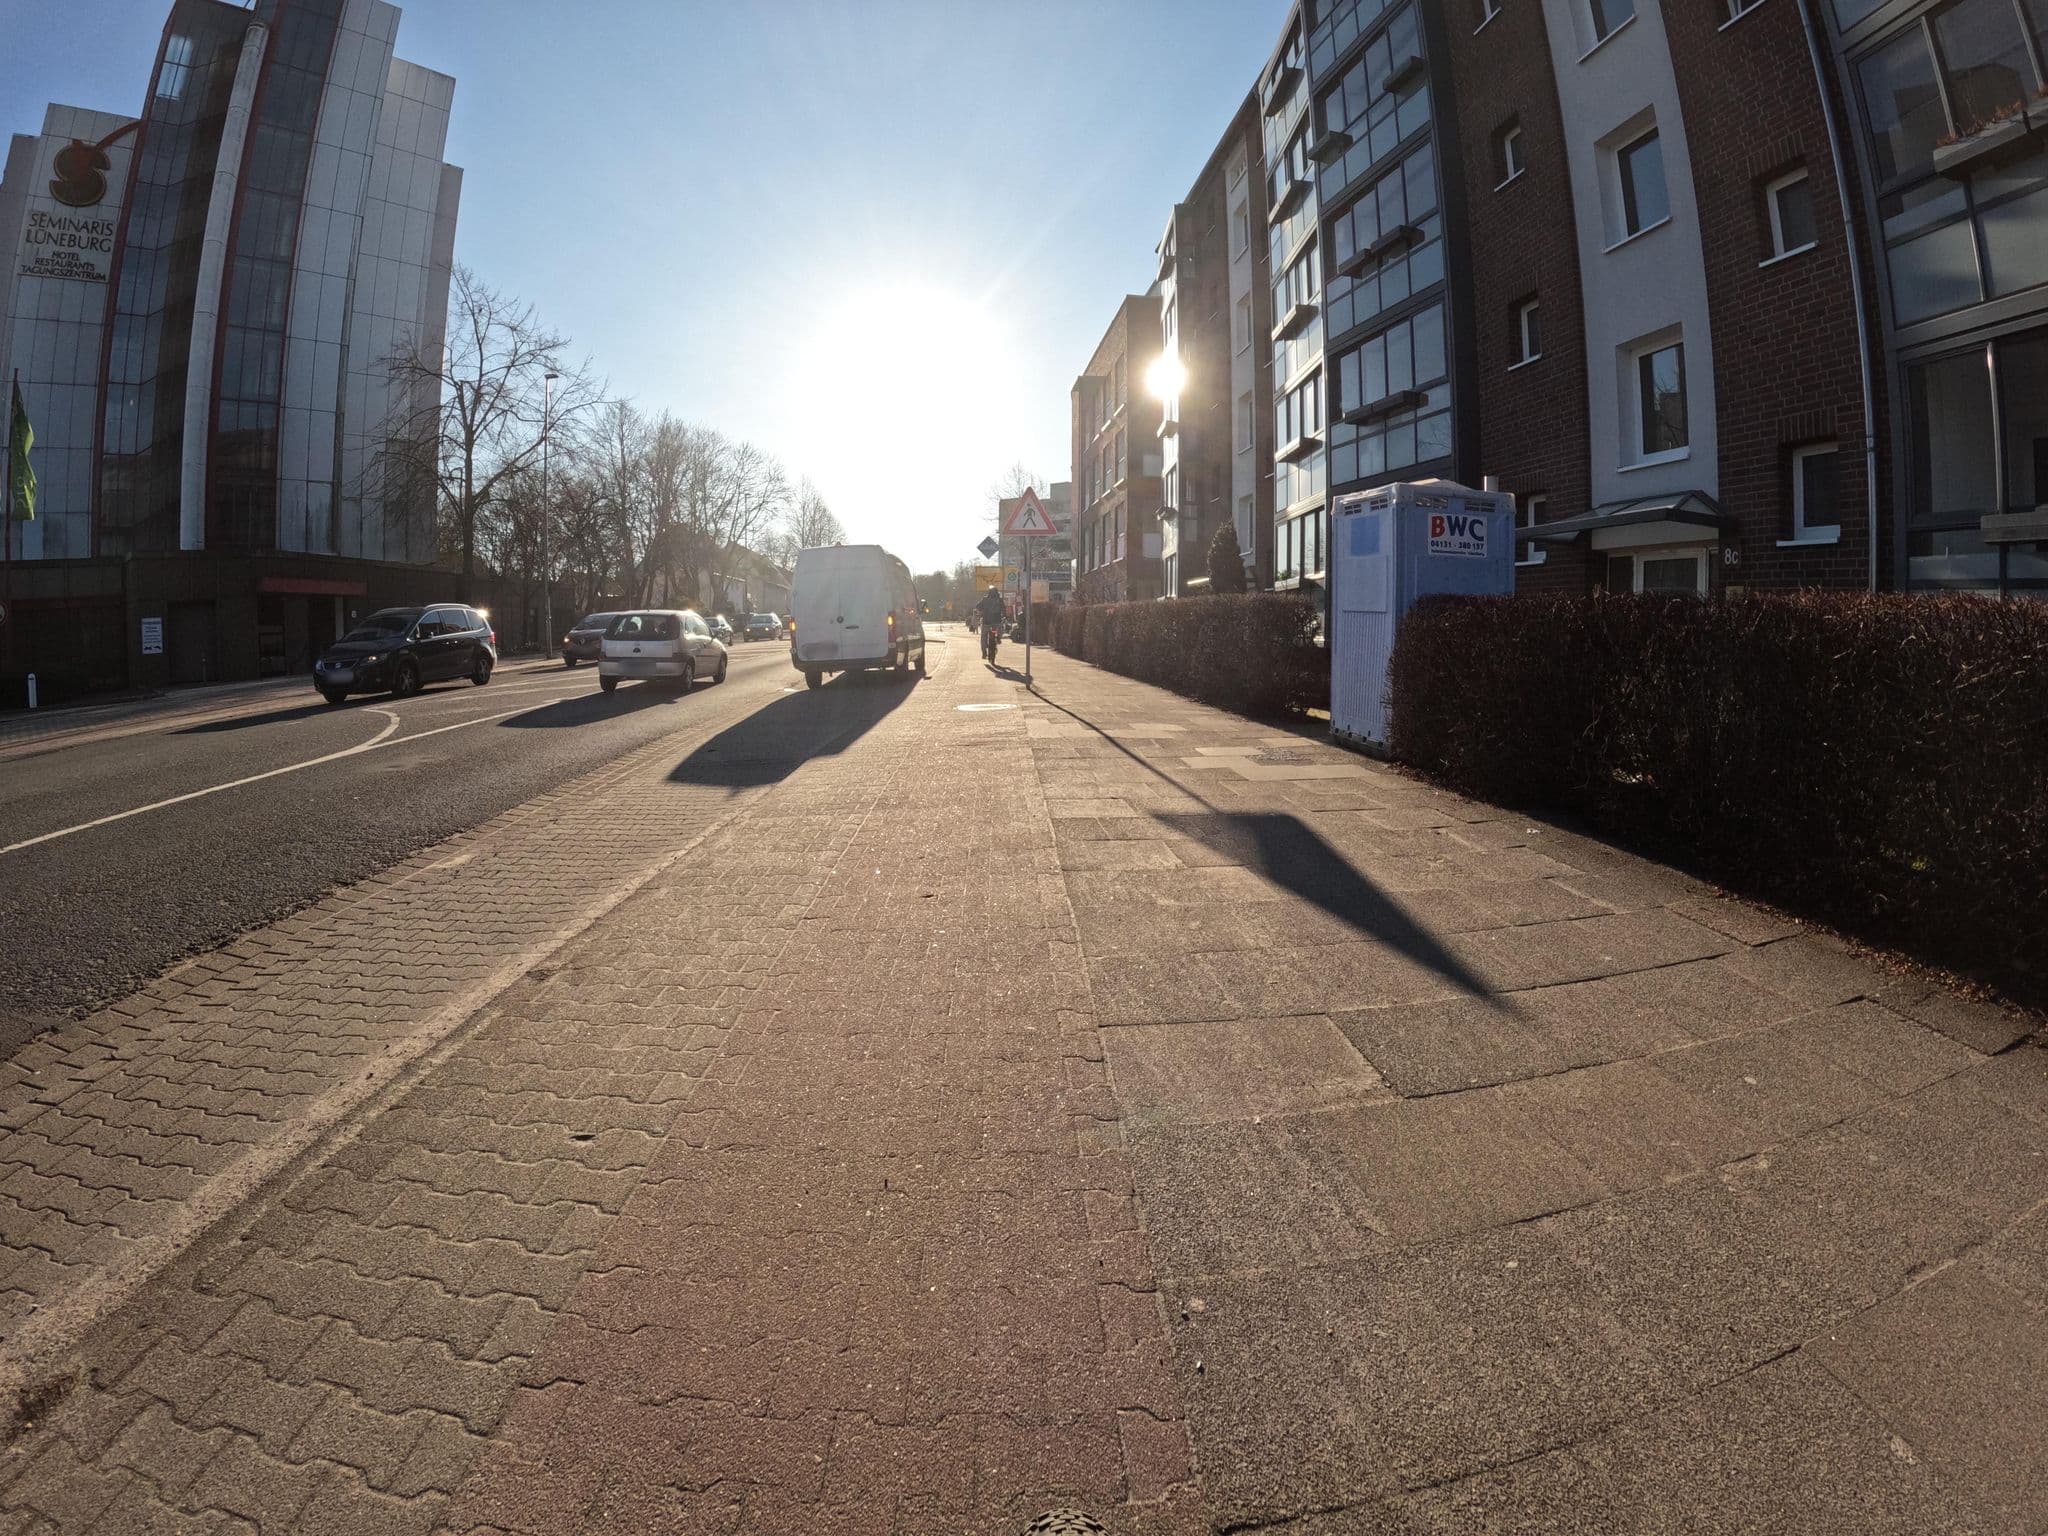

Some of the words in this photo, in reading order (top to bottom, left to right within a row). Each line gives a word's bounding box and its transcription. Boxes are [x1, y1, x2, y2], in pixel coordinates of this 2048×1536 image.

[28, 212, 114, 236] SEMINARIS
[25, 228, 112, 253] LÜNEBURG
[34, 257, 96, 272] RESTAURANTS
[52, 250, 80, 261] HOTEL
[21, 264, 107, 281] TAGUNGSZENTRUM
[1431, 515, 1485, 542] BWC
[1724, 547, 1739, 565] 8c
